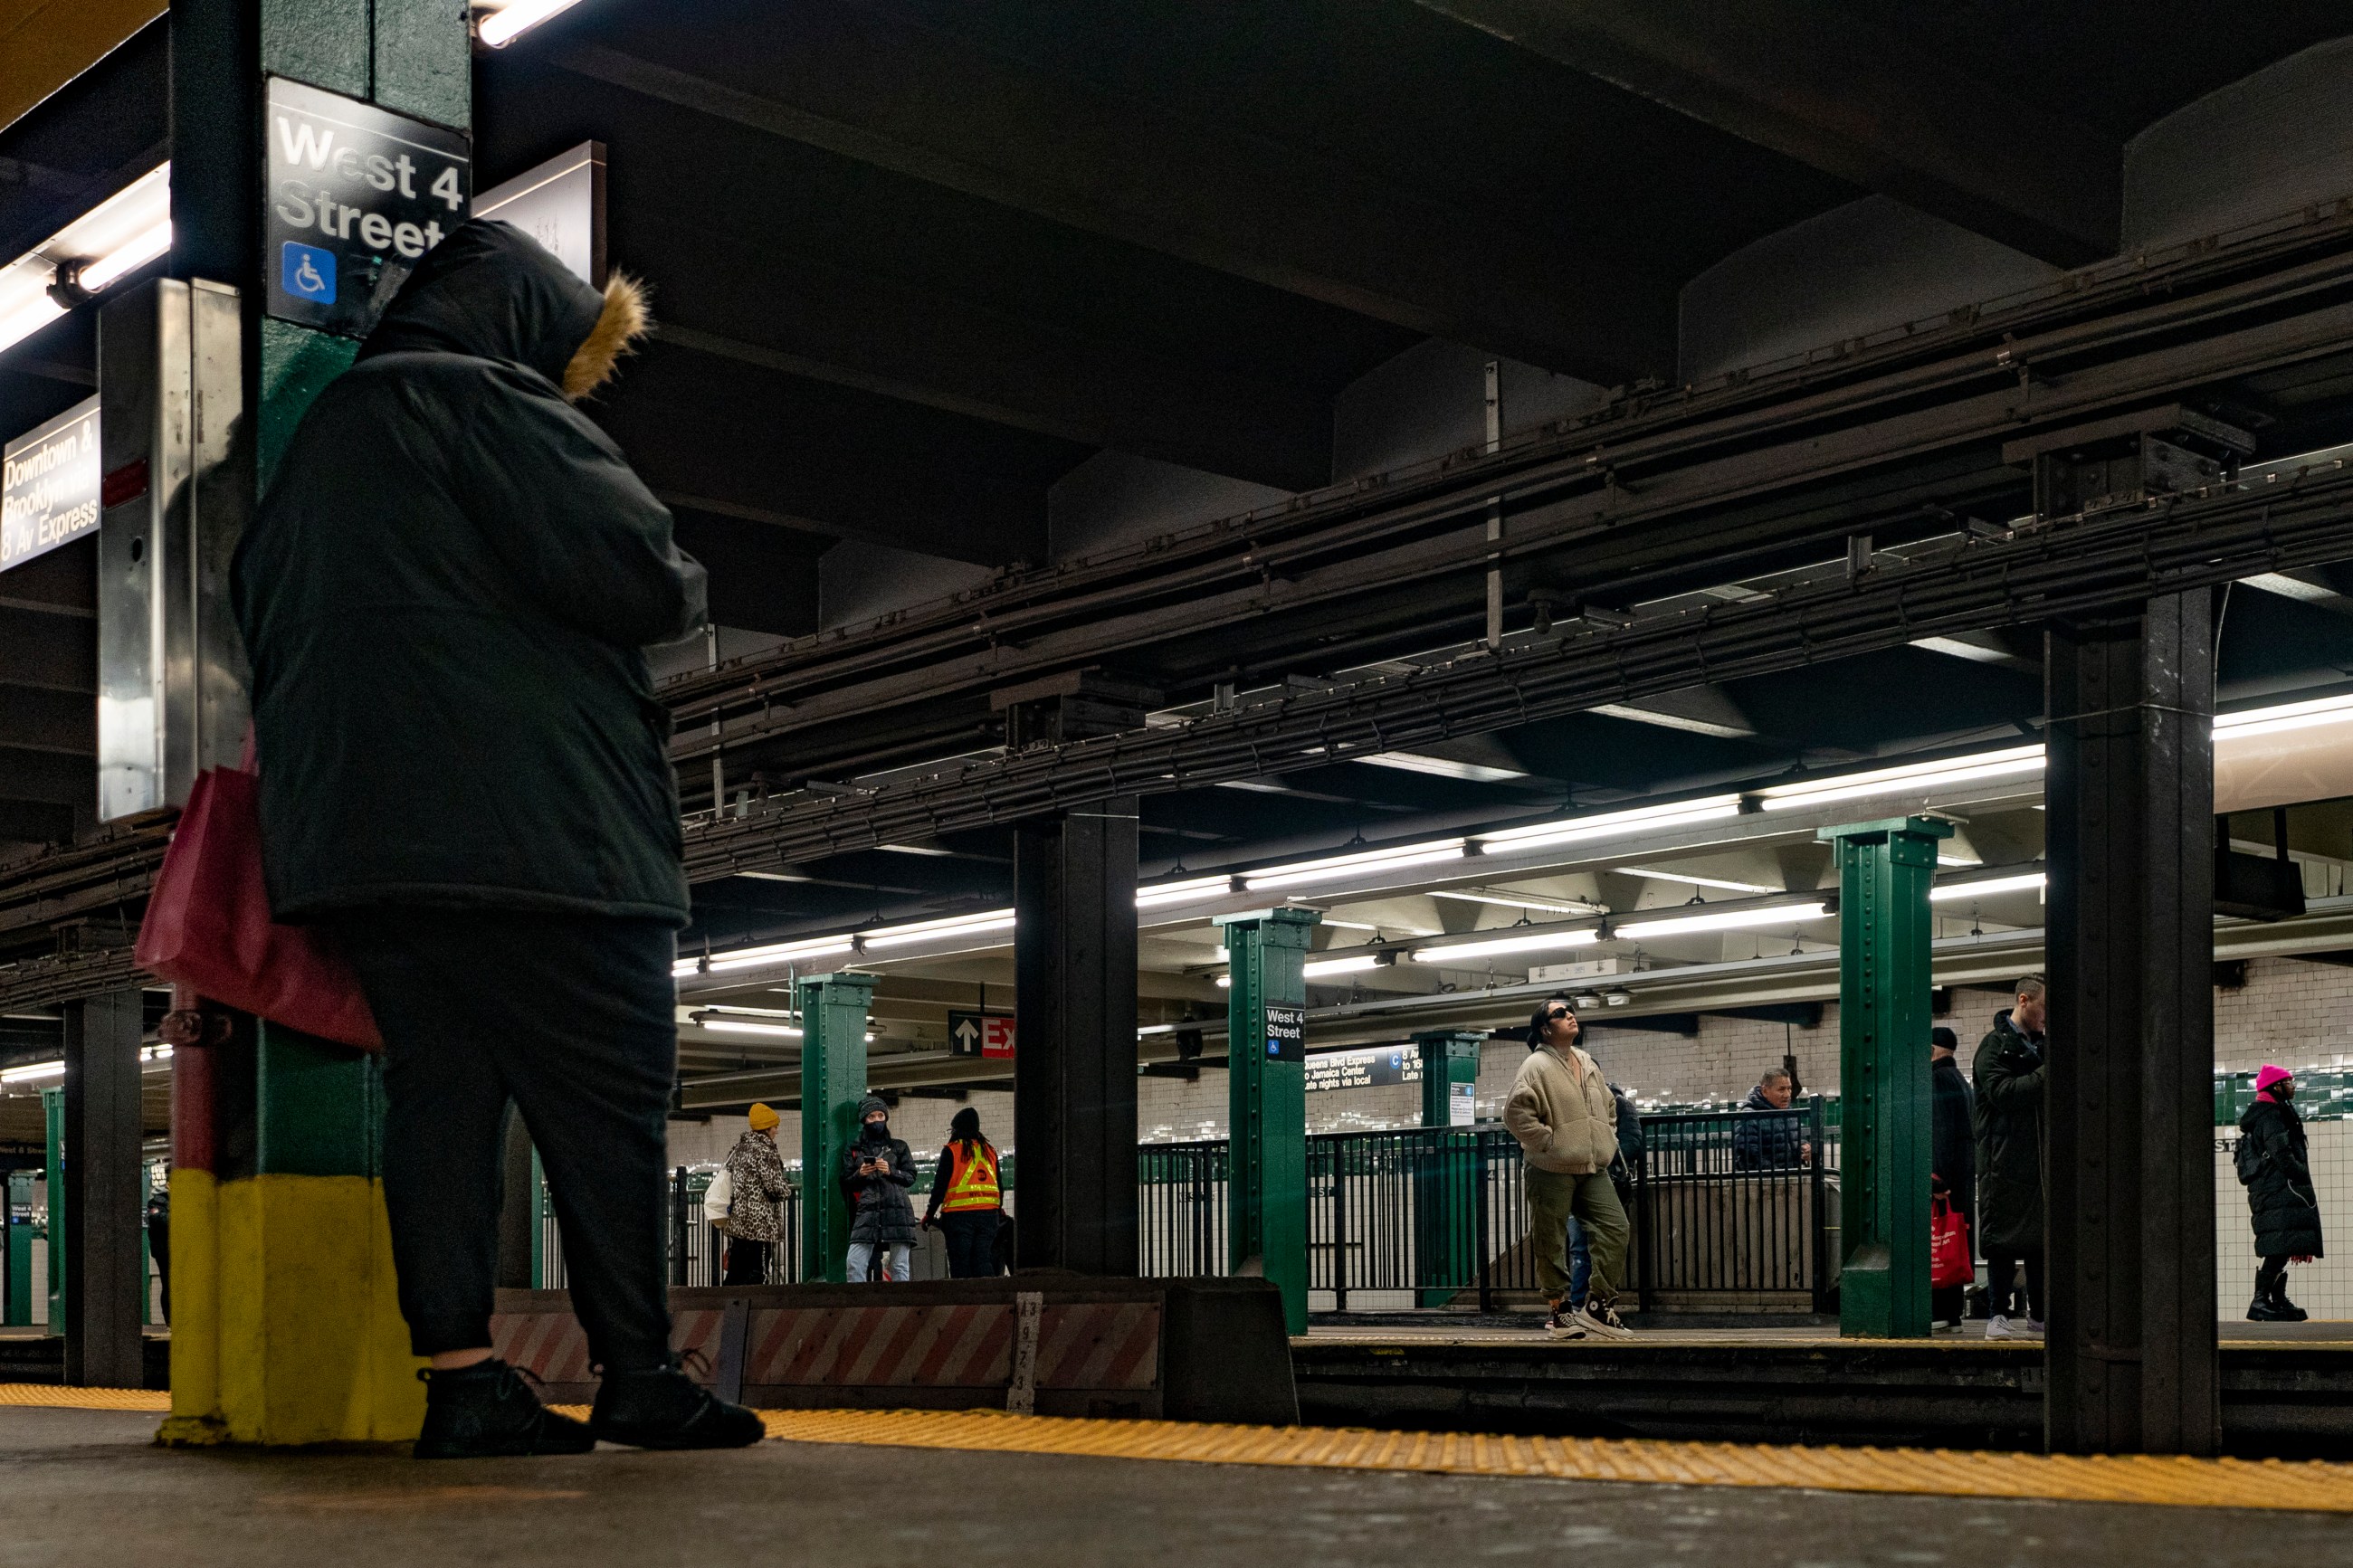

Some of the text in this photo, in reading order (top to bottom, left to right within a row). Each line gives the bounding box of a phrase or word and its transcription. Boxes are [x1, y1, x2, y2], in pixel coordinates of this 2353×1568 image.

[277, 117, 463, 211] West 4
[277, 180, 446, 259] Street
[5, 420, 92, 492] Downtown &
[3, 462, 90, 527] Brooklyn via
[1, 499, 98, 562] 8 Av Express
[1267, 1009, 1303, 1024] West 4
[1267, 1023, 1300, 1039] Street
[1330, 1057, 1345, 1067] Blvd
[1348, 1055, 1376, 1067] Express
[1392, 1055, 1399, 1065] C
[1402, 1049, 1419, 1060] 8 Av
[1402, 1060, 1410, 1069] to
[1311, 1069, 1339, 1079] Jamaica
[1341, 1066, 1366, 1077] Center
[1402, 1071, 1418, 1080] Late
[1304, 1074, 1371, 1090] ate nights via local
